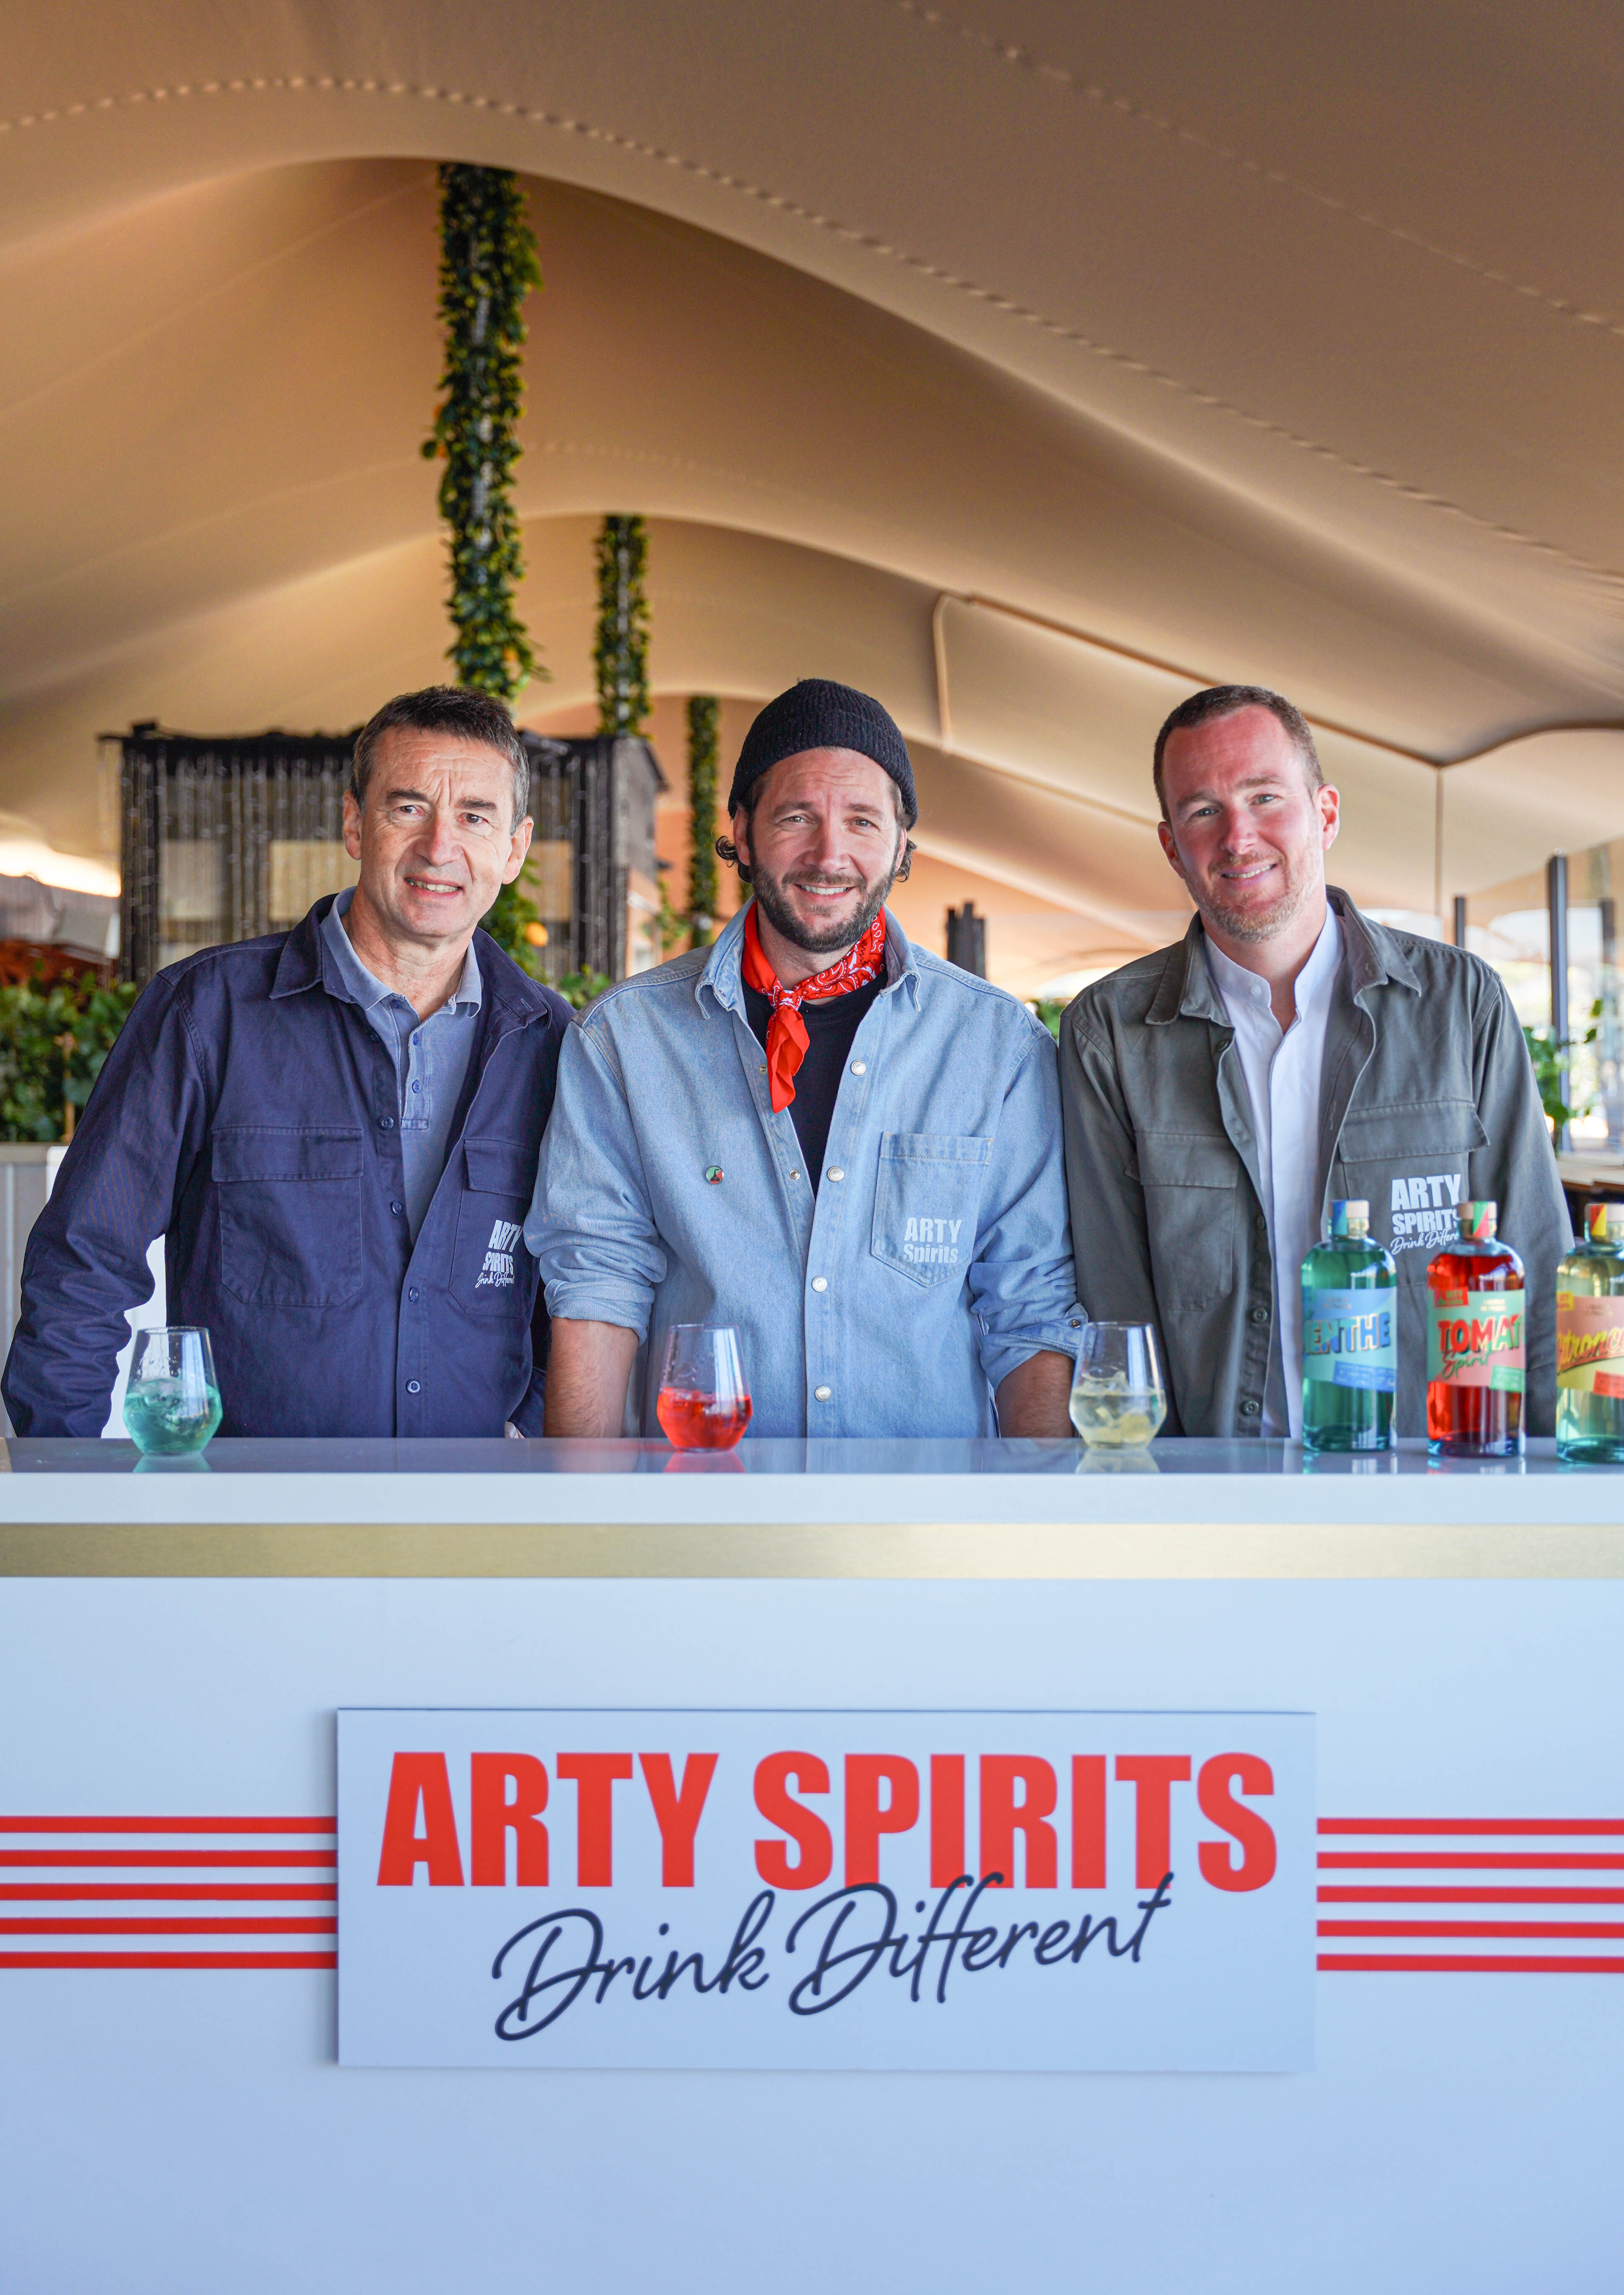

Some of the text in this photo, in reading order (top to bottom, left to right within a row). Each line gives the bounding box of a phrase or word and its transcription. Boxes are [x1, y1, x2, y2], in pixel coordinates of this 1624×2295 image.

[1391, 1174, 1461, 1211] ARTY
[488, 1220, 523, 1252] ARTY
[904, 1217, 962, 1243] ARTY
[1390, 1233, 1424, 1254] Drink
[482, 1251, 513, 1275] SPIRITS
[903, 1243, 958, 1264] Spirits
[475, 1271, 515, 1288] Drink Different
[1302, 1312, 1391, 1355] ENTHE
[1442, 1347, 1493, 1379] Spirit
[378, 1750, 1277, 1891] ARTY SPIRITS
[492, 1871, 1174, 2041] Drink Different
